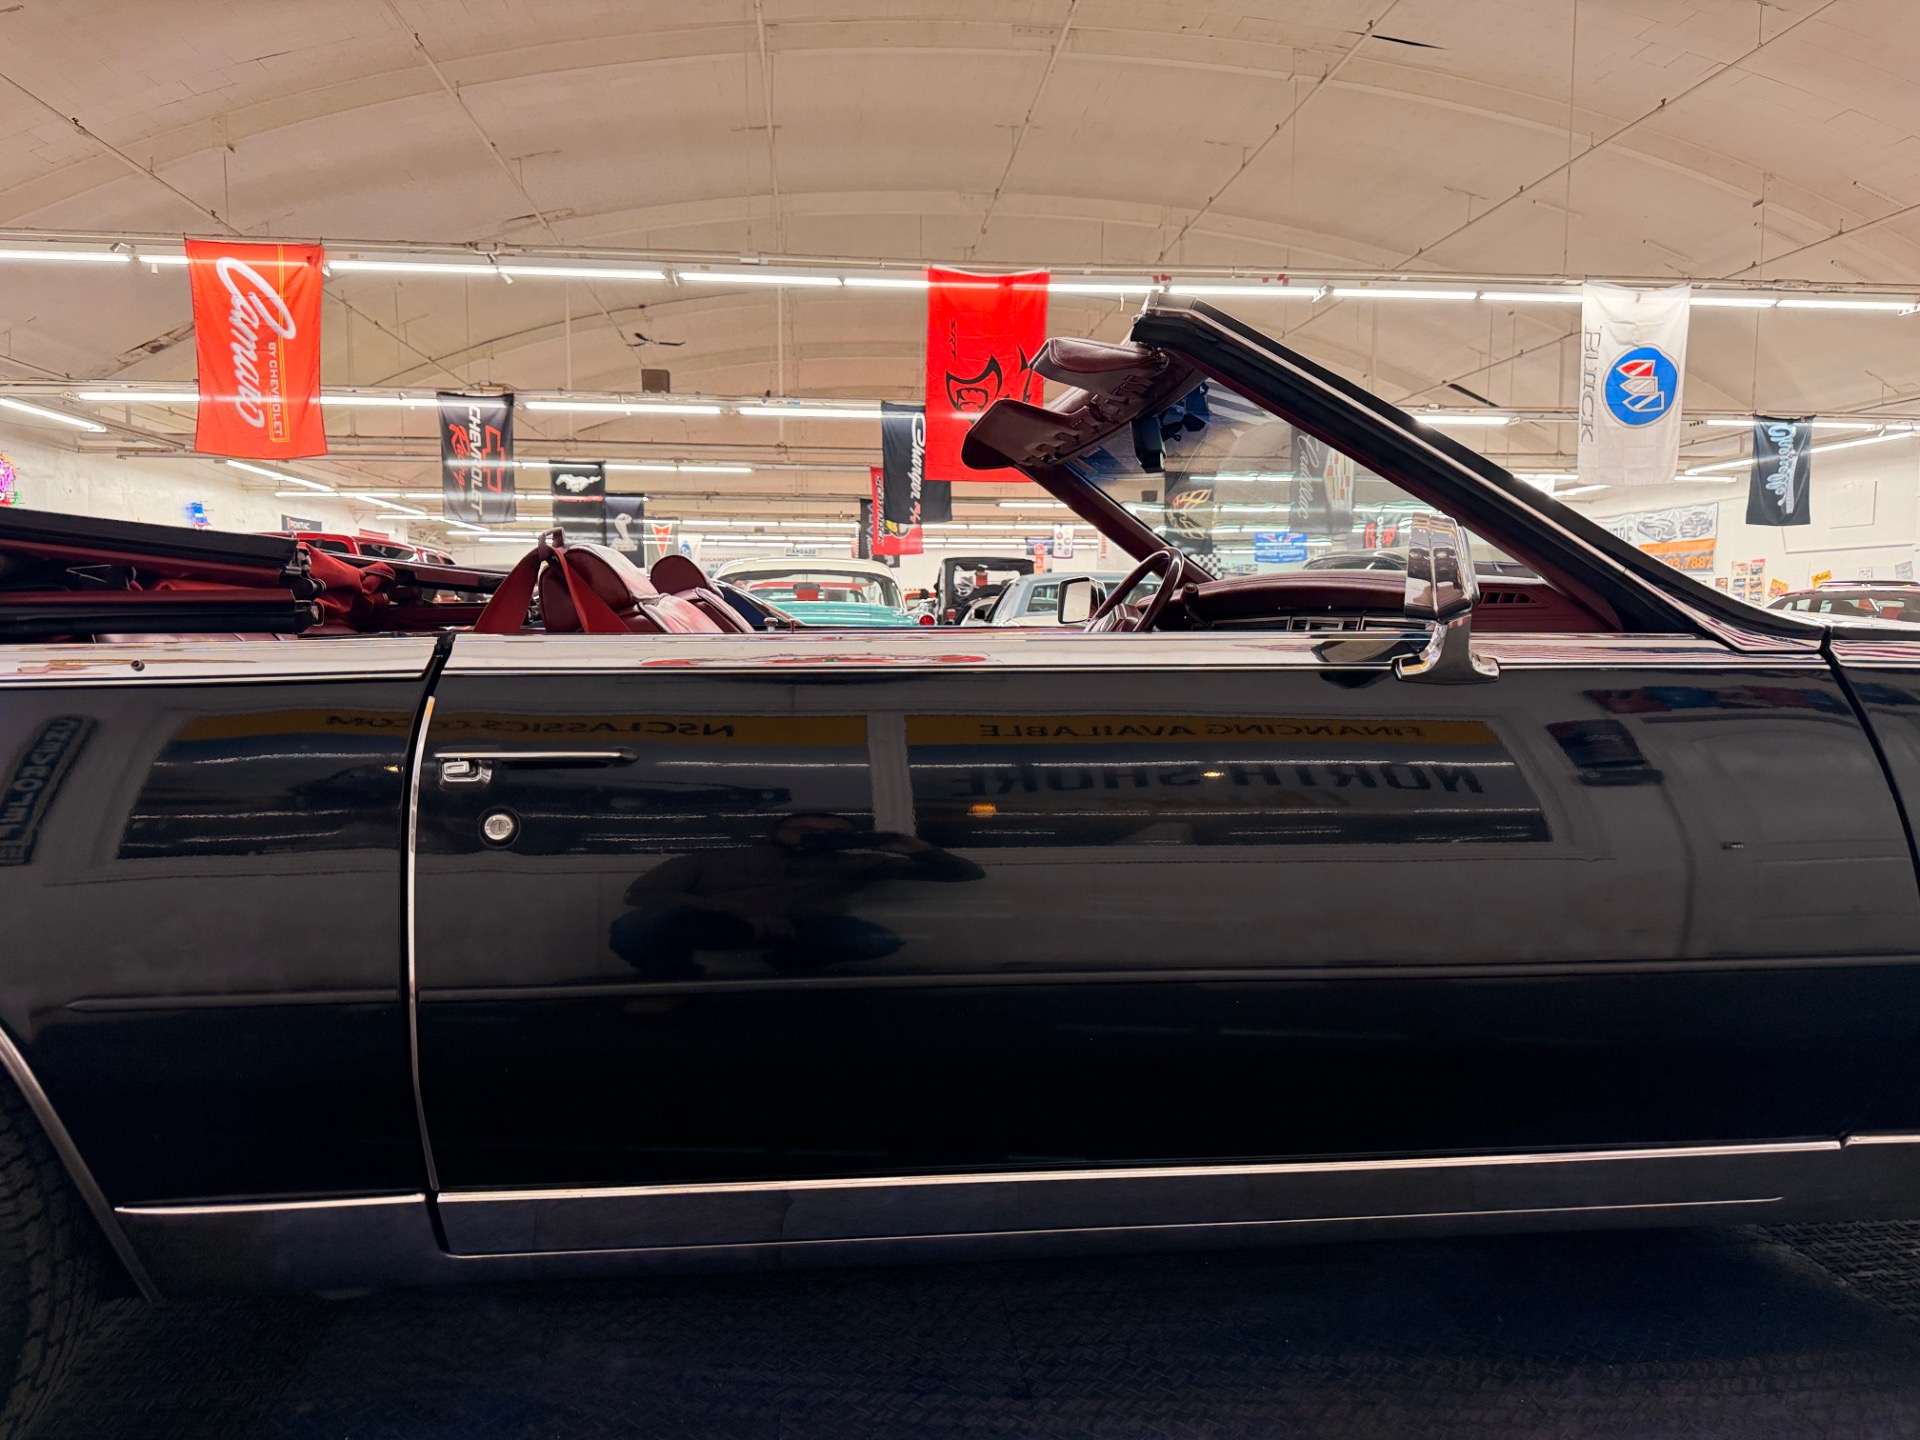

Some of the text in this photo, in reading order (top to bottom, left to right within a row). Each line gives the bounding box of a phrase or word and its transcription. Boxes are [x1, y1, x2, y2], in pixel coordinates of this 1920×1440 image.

[216, 256, 296, 428] Camaro
[268, 341, 283, 437] BY CHEVROLET
[1580, 324, 1602, 443] BUICK
[449, 423, 471, 488] Racng
[468, 405, 482, 515] CHEVROLET
[907, 412, 926, 499] Charger
[1297, 434, 1319, 519] Cadillac
